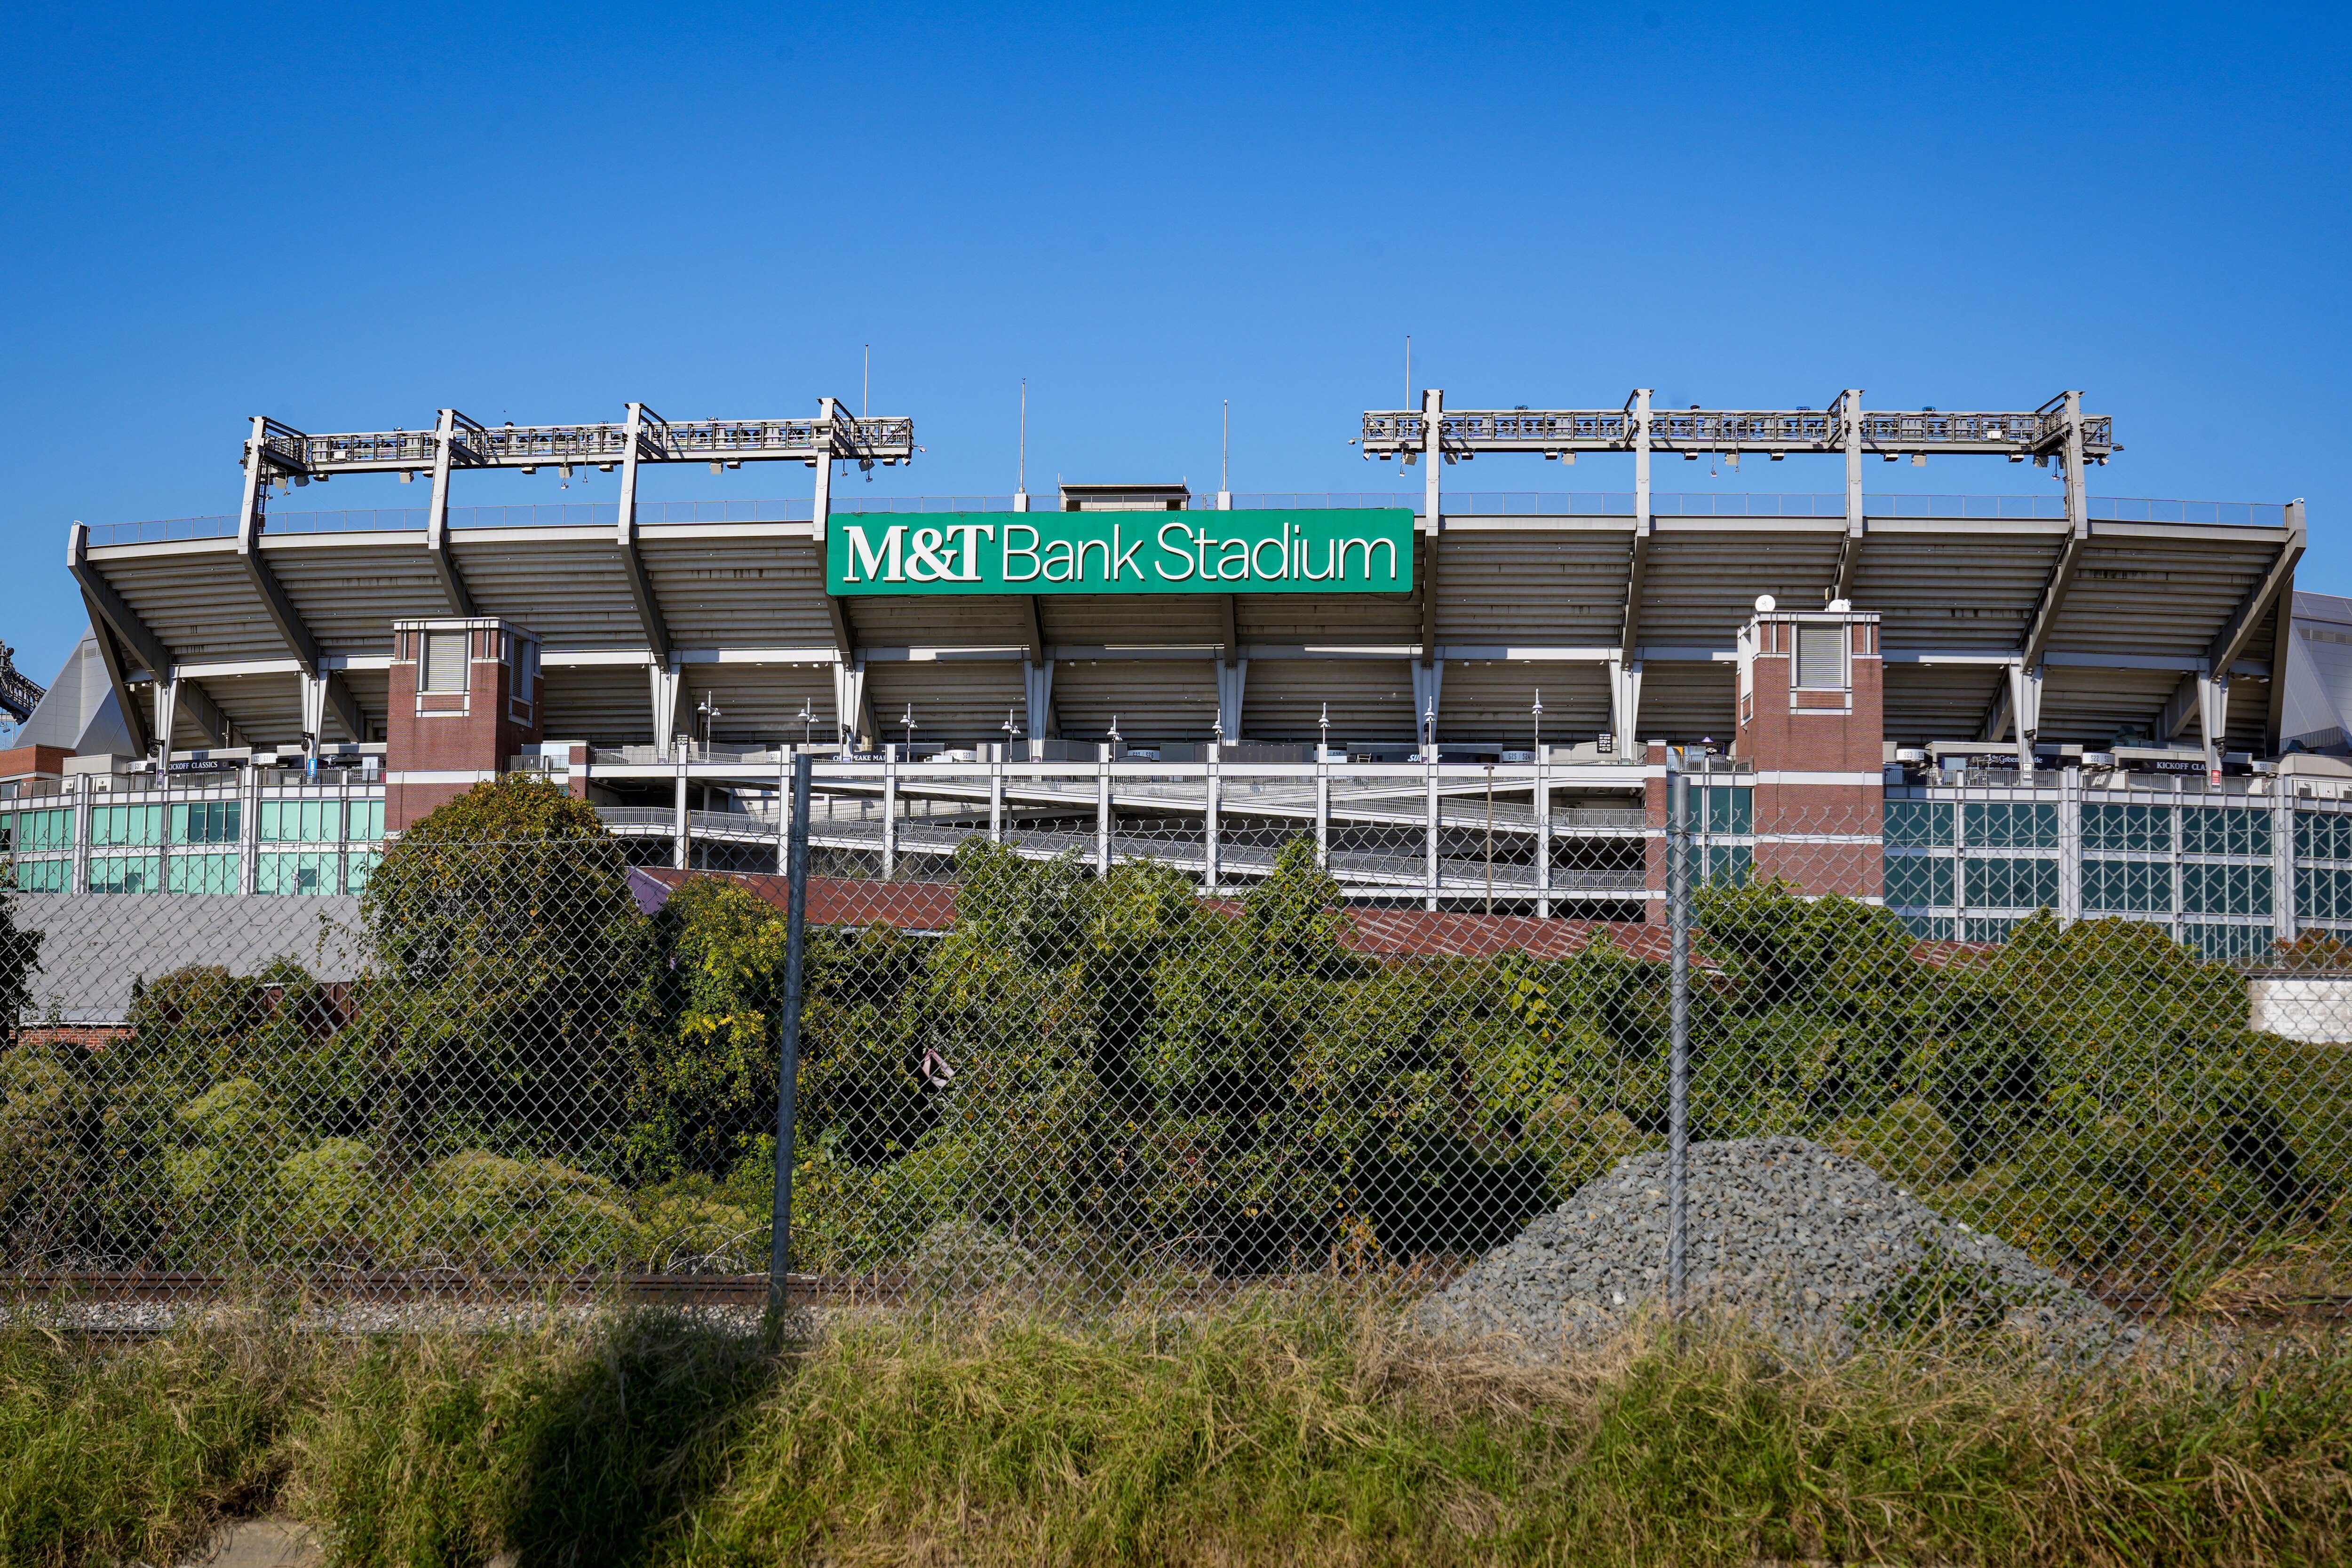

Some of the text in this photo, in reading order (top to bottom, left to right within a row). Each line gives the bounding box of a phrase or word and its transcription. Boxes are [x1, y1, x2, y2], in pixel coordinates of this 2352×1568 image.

[843, 522, 1396, 581] M&T Bank Stadium
[1999, 755, 2019, 764] Green
